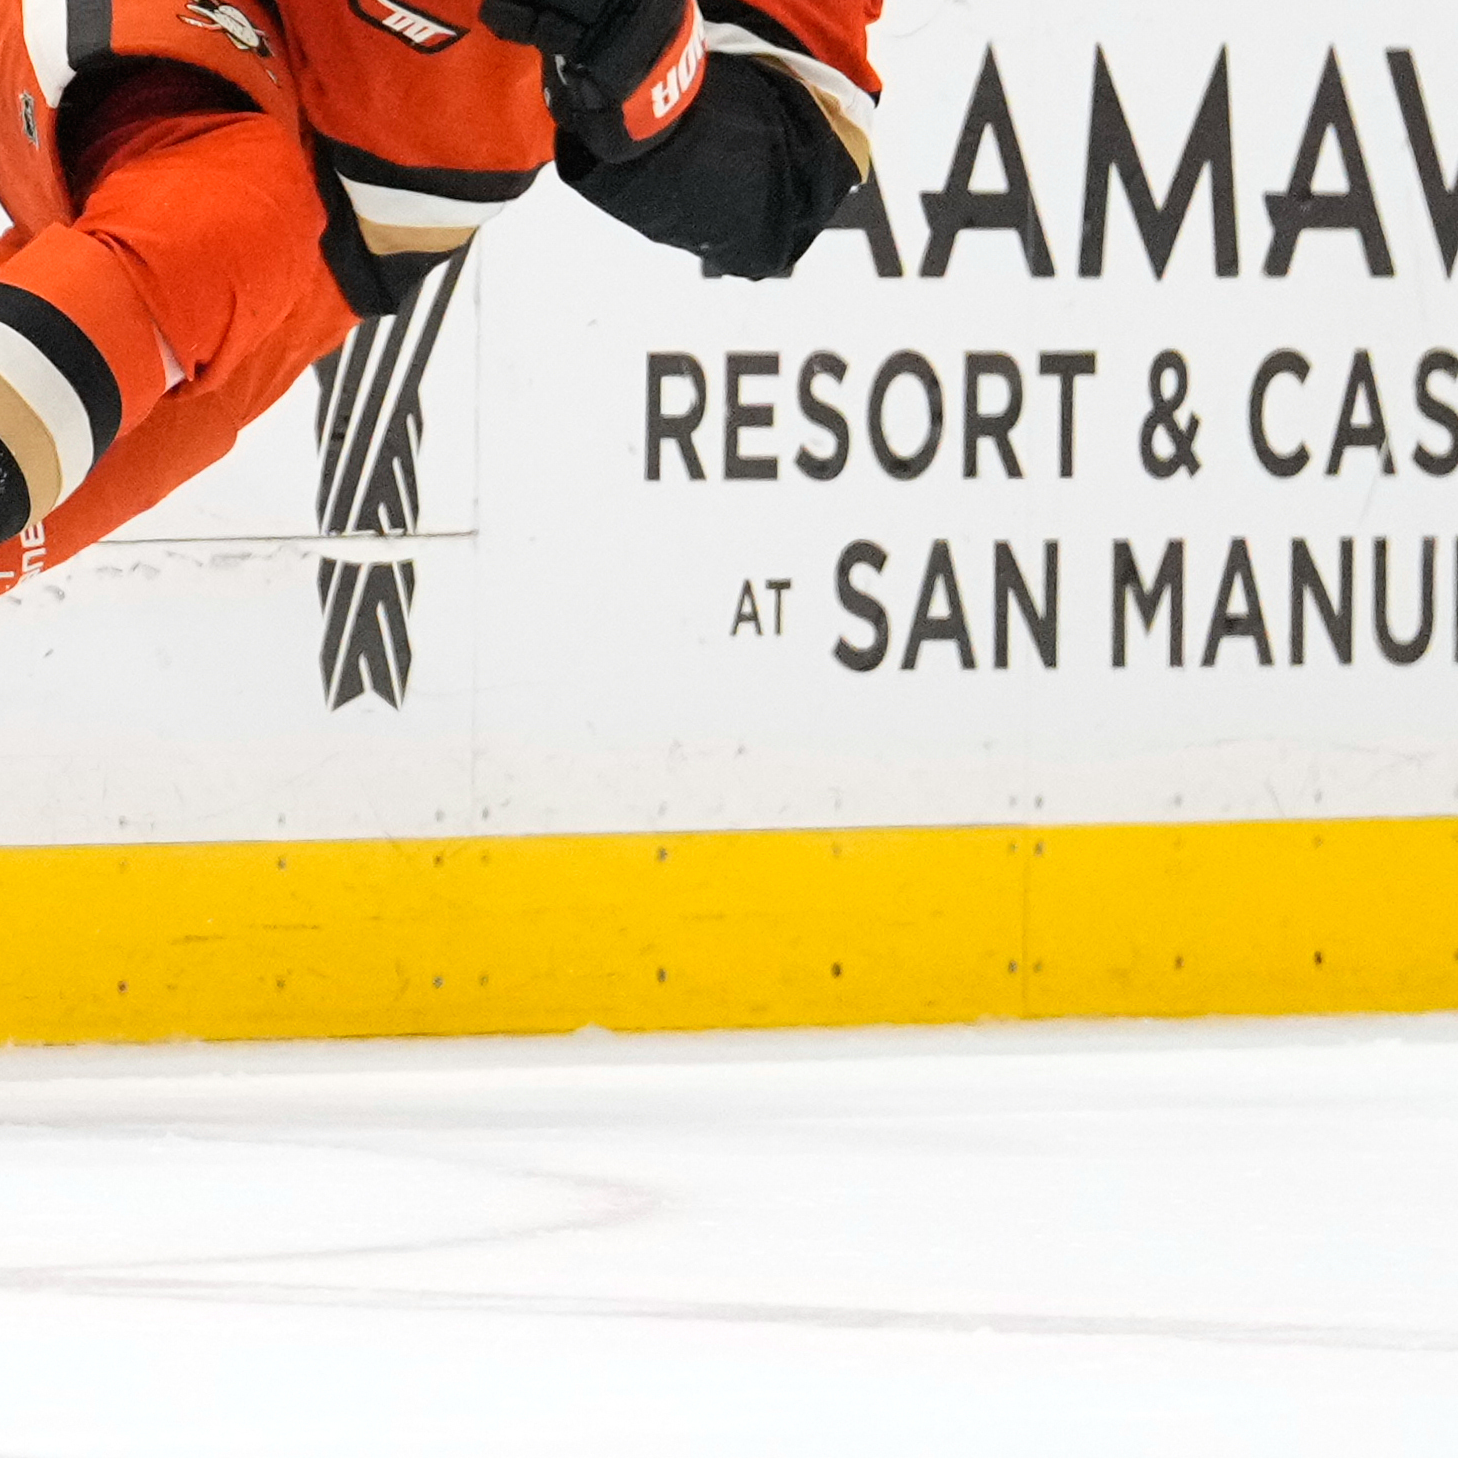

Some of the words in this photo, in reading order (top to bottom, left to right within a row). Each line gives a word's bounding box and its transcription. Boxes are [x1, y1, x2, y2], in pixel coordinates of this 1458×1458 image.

[644, 350, 1097, 482] RESORT
[1138, 347, 1202, 480] &
[730, 578, 792, 637] AT
[831, 538, 1059, 672] SAN
[1110, 536, 1458, 668] MANU
